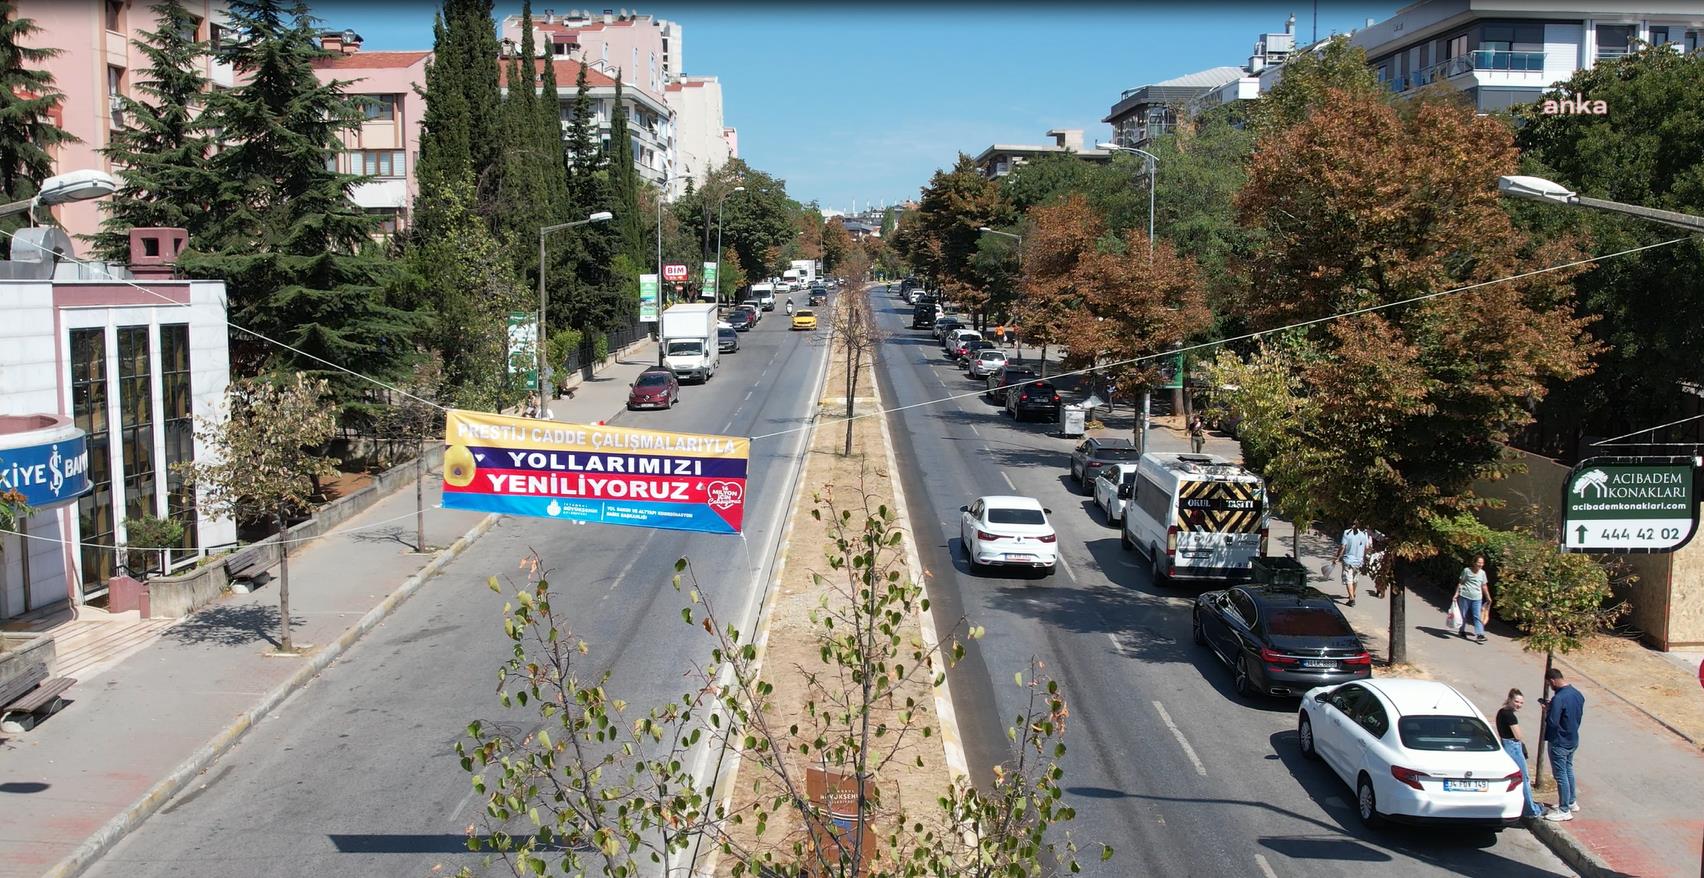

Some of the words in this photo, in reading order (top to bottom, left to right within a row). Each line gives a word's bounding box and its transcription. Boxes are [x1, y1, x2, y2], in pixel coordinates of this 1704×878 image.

[457, 422, 526, 441] PRESTİJ
[531, 428, 586, 445] CADDE
[591, 431, 736, 453] ÇALIŞMALARIYLA
[507, 452, 702, 476] YOLLARIMIZI
[1612, 472, 1682, 484] ACIBADEM
[486, 473, 690, 499] YENİLİYORUZ
[1608, 487, 1686, 498] KONAKLARI
[1187, 499, 1211, 507] OKUL
[1572, 502, 1687, 511] acibademkonaklari.com
[1601, 528, 1630, 540] 444
[1636, 528, 1654, 540] 42
[1660, 528, 1680, 540] 02
